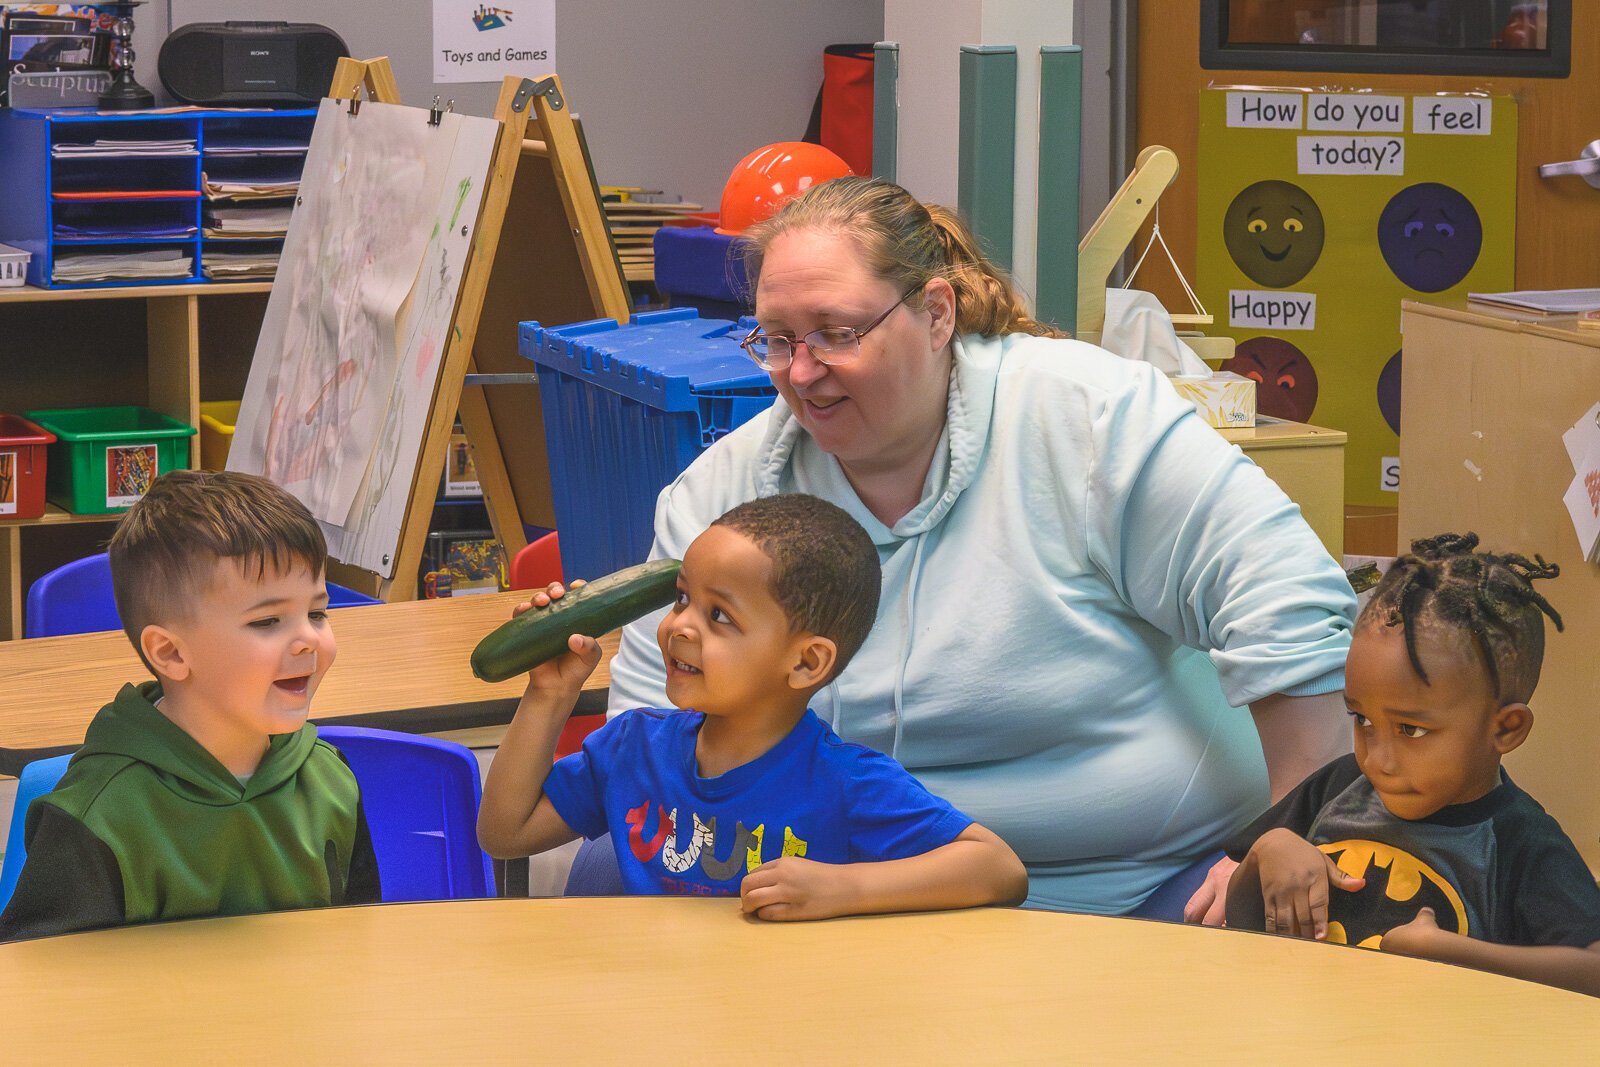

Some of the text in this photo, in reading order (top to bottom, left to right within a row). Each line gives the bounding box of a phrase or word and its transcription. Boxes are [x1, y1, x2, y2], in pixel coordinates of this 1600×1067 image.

[442, 48, 547, 65] Toys and Games
[9, 63, 110, 97] Sculptur
[1241, 97, 1482, 131] How do you feel
[1311, 140, 1402, 171] today?
[1231, 294, 1312, 326] Happy
